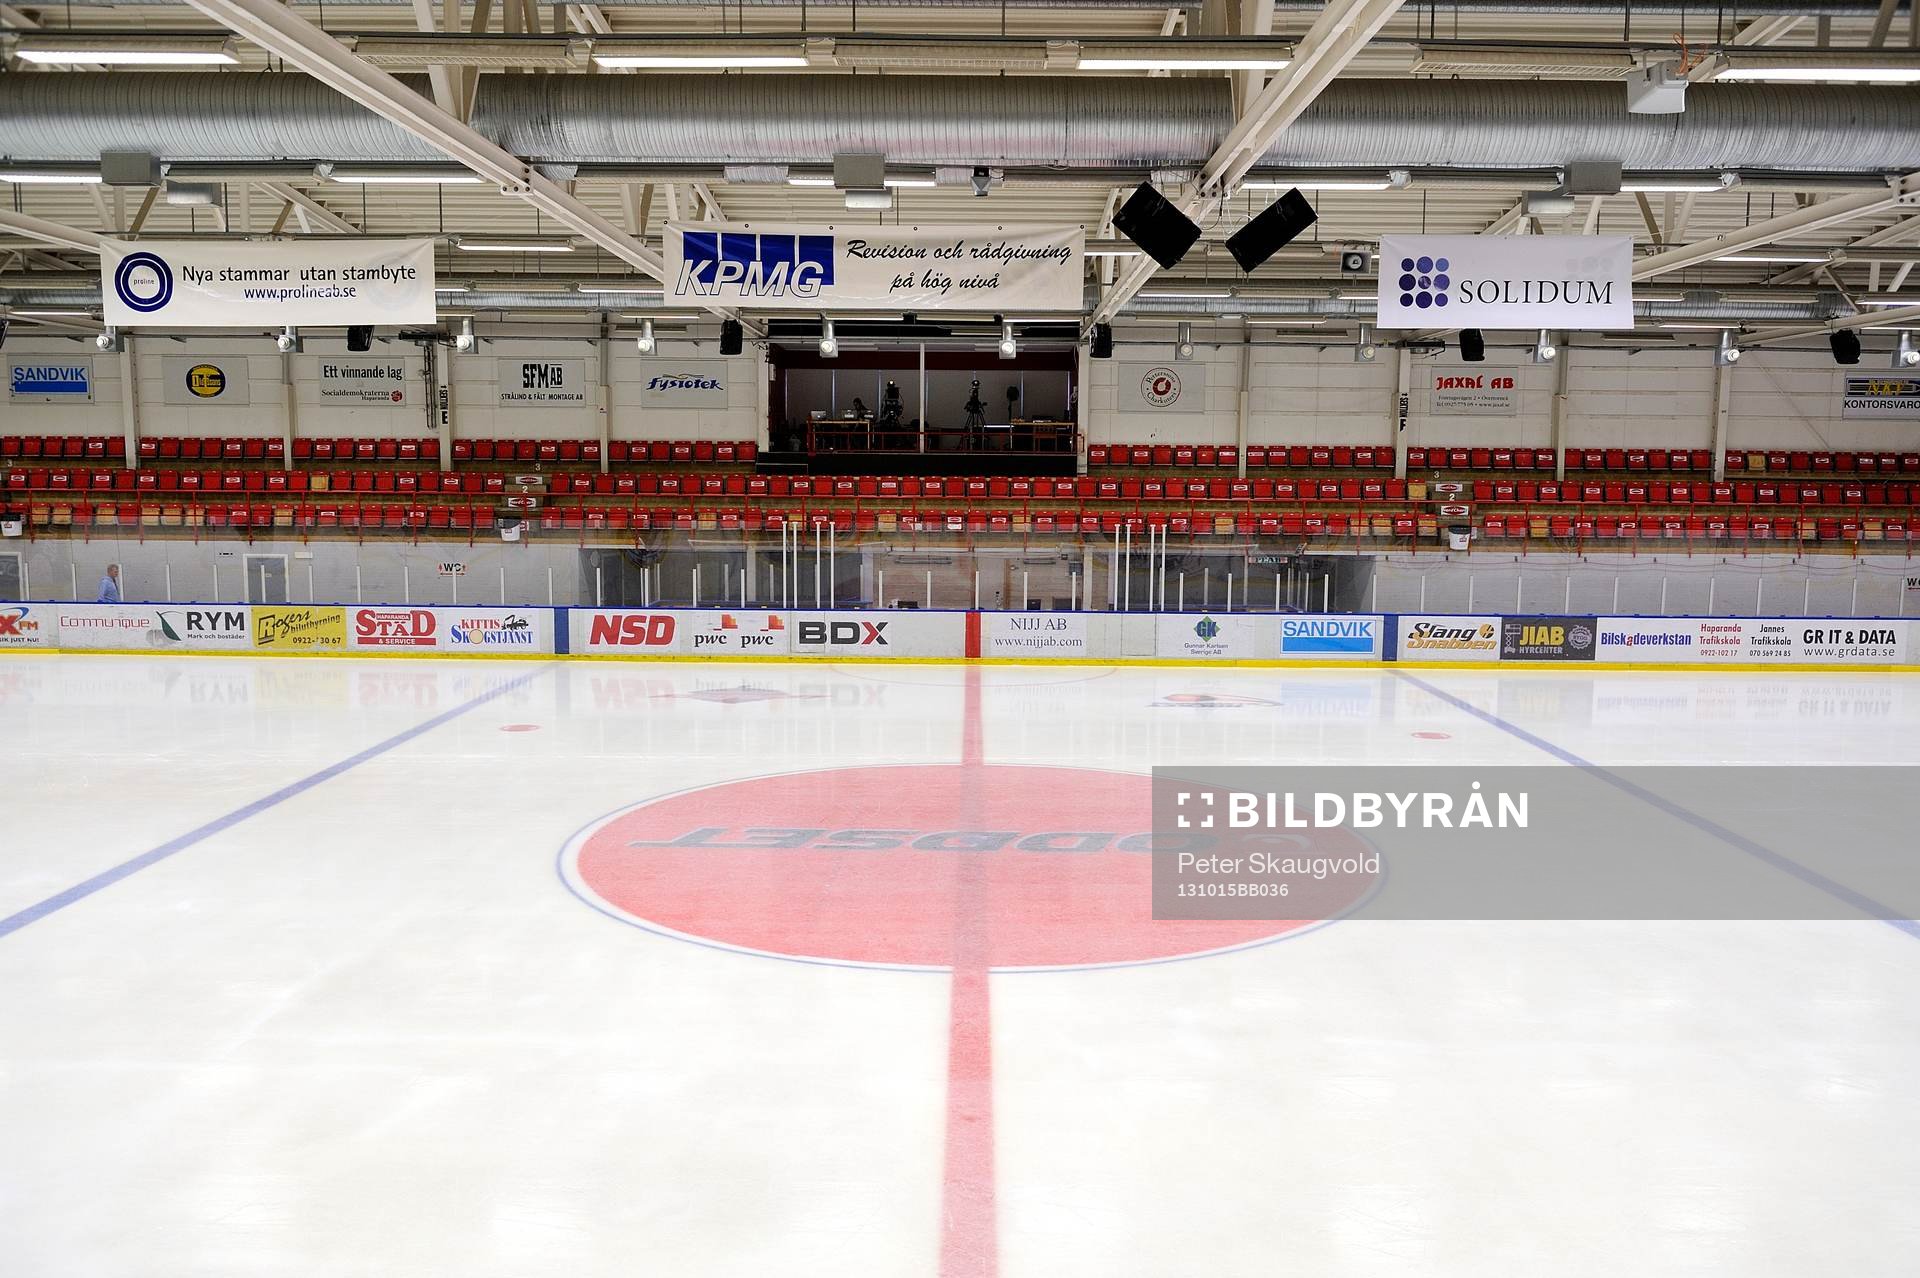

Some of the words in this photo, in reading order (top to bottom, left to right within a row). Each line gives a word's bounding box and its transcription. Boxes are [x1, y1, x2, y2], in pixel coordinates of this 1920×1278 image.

[846, 239, 927, 258] Revision
[934, 240, 964, 258] och
[969, 242, 1072, 266] rådgivning
[182, 266, 213, 285] Nya
[219, 267, 289, 281] stammar
[300, 267, 336, 281] utan
[342, 265, 416, 284] stambyte
[675, 259, 824, 298] KPMG
[889, 271, 915, 293] på
[921, 268, 953, 295] hög
[959, 272, 1000, 289] nivå
[244, 284, 357, 302] www.prolineab.se
[1459, 279, 1613, 305] SOLIDUM
[14, 367, 87, 381] SANDVIK
[323, 365, 338, 378] Ett
[341, 365, 384, 378] vinnande
[387, 365, 402, 380] lag
[522, 363, 549, 388] SFM
[550, 365, 563, 386] AB
[1436, 374, 1483, 390] JAXAL
[1490, 377, 1514, 389] AB
[321, 389, 390, 397] Socialdemokraterna
[501, 392, 527, 400] STRÅLIND
[1844, 400, 1920, 409] KONTORSVARO
[535, 463, 541, 471] 3
[1433, 470, 1440, 479] 3
[522, 485, 529, 494] 2
[1449, 493, 1455, 502] 2
[443, 562, 461, 572] WC
[1907, 577, 1920, 586] W
[20, 621, 38, 631] FM
[186, 611, 245, 631] RYM
[290, 614, 341, 634] biluthyrning
[356, 609, 436, 636] STÄD
[461, 618, 500, 630] KITTIS
[1010, 618, 1041, 631] NIJJ
[1045, 618, 1067, 631] AB
[589, 614, 677, 645] NSD
[799, 621, 888, 645] BDX
[1196, 620, 1217, 637] GK
[1283, 621, 1372, 637] SANDVIK
[1408, 622, 1478, 642] Slang
[1701, 623, 1742, 634] Haparanda
[1759, 624, 1785, 633] Jannes
[331, 636, 341, 644] 67
[694, 633, 727, 647] pwc
[741, 634, 774, 648] pwc
[994, 635, 1082, 649] www.nijjab.com
[1519, 626, 1565, 646] JIAB
[1601, 632, 1692, 646] Bilskadeverkstan
[1699, 636, 1741, 645] Trafikskola
[1751, 636, 1792, 645] Trafikskola
[1803, 629, 1824, 645] GR
[1828, 629, 1842, 645] IT
[1845, 630, 1855, 644] &
[1858, 629, 1896, 645] DATA
[1519, 646, 1563, 654] HYRCENTER
[1804, 646, 1895, 658] www.grdata.se
[628, 826, 1219, 854] ODDSET
